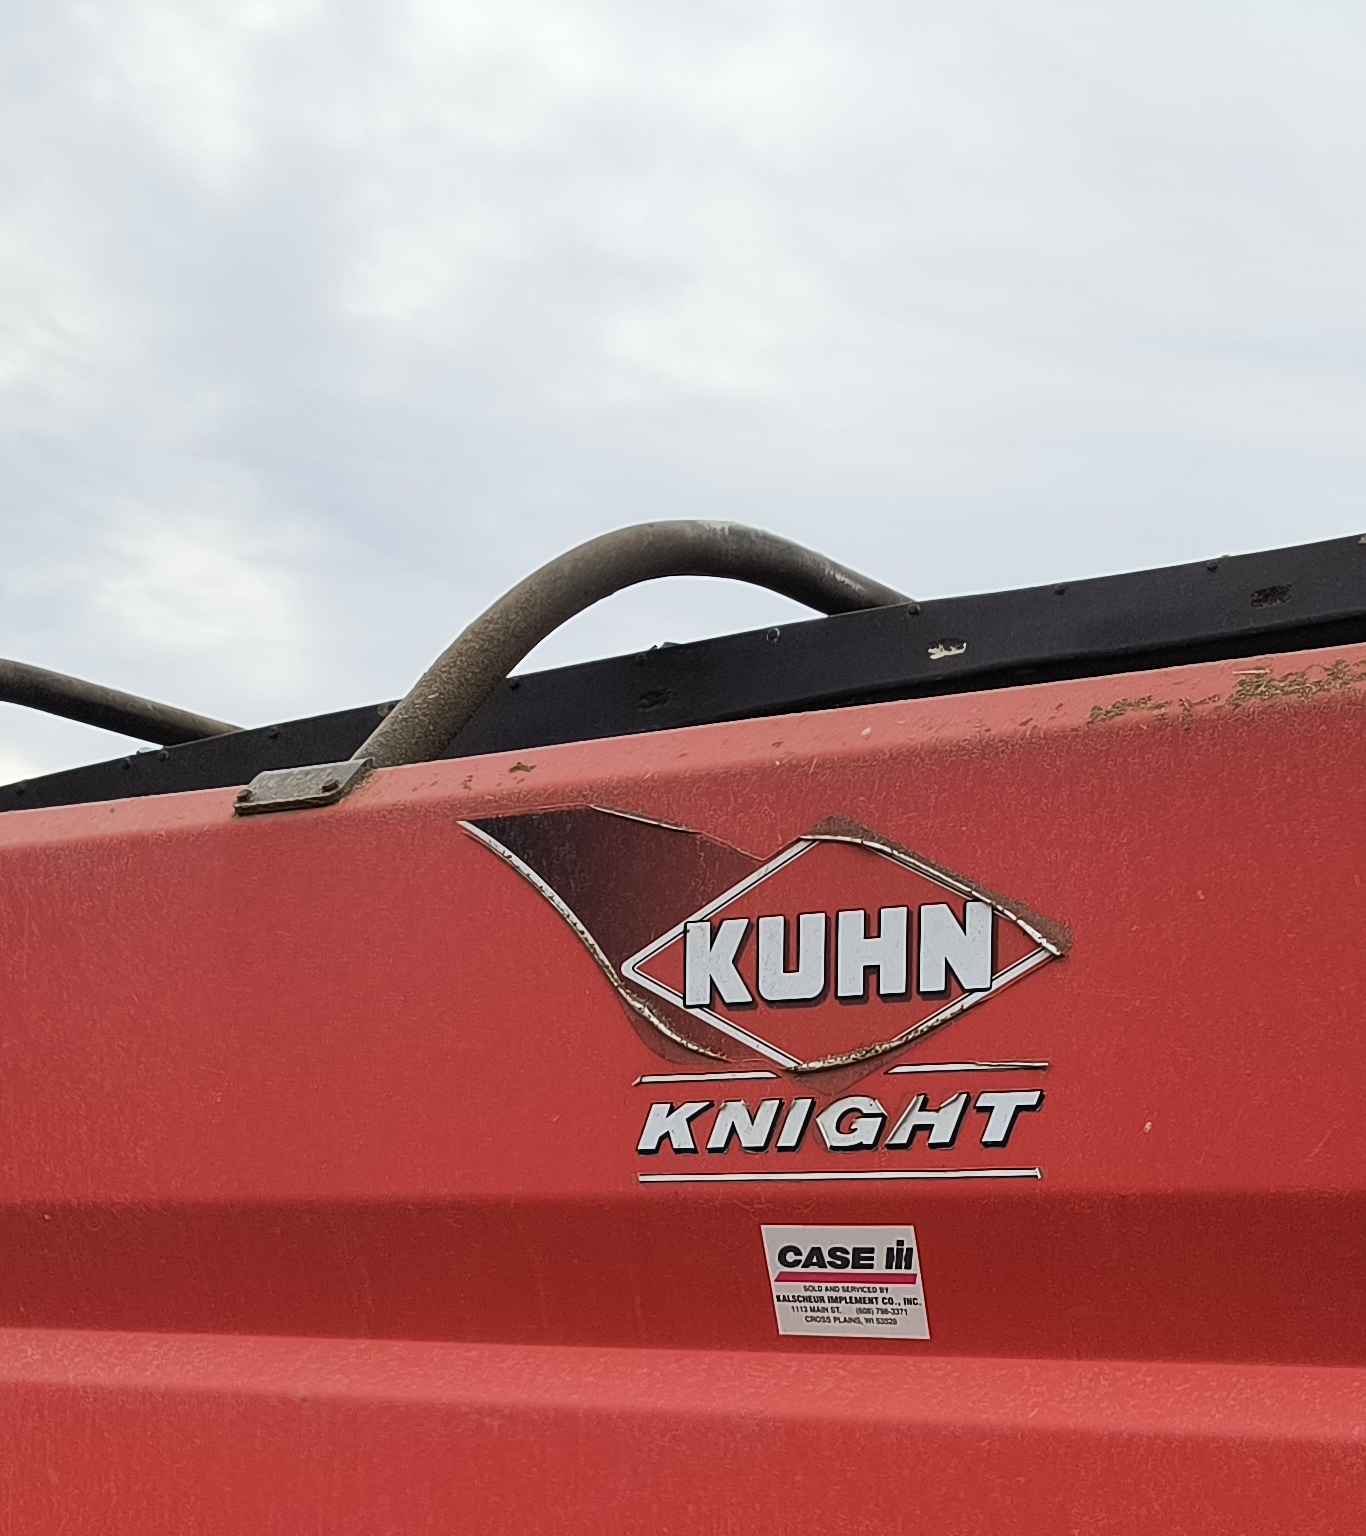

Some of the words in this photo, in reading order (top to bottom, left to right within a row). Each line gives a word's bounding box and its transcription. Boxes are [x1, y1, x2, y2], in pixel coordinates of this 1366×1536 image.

[683, 900, 994, 1008] KUHN
[637, 1090, 1044, 1155] KNIGHT
[778, 1245, 875, 1269] CASE
[803, 1284, 823, 1293] SOLD
[824, 1285, 840, 1293] AND
[841, 1285, 878, 1294] SERVICED
[879, 1286, 889, 1294] BY
[827, 1295, 879, 1305] IMPLEMENT
[903, 1297, 923, 1306] INC.
[809, 1305, 829, 1313] MAIN
[804, 1315, 831, 1324] CROSS
